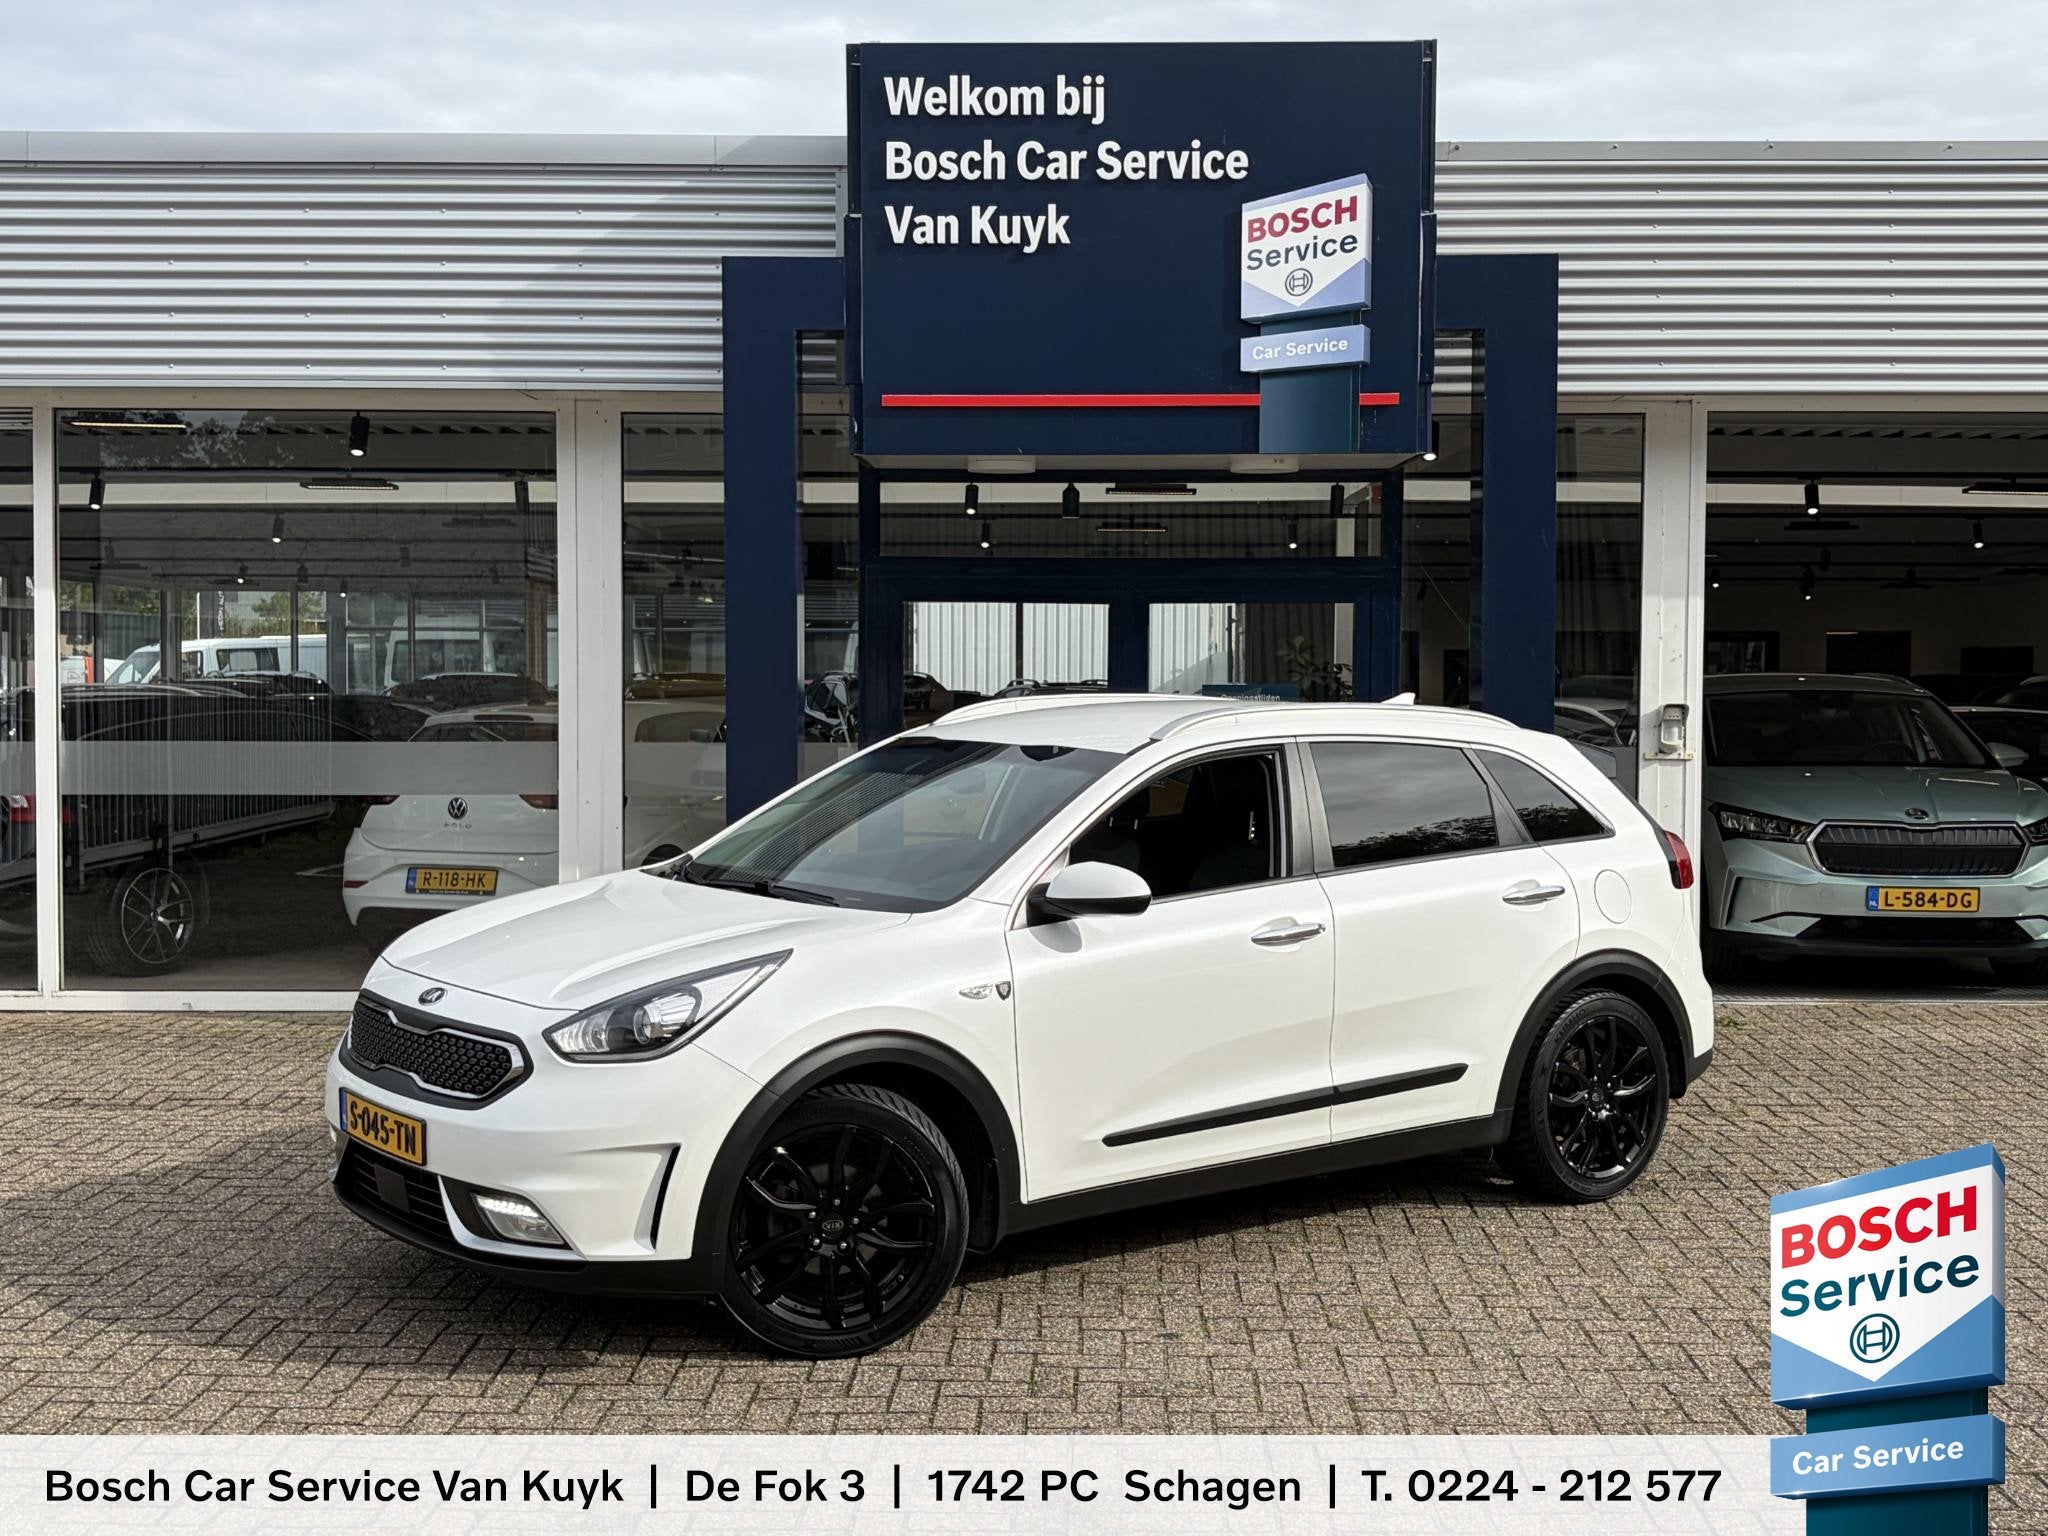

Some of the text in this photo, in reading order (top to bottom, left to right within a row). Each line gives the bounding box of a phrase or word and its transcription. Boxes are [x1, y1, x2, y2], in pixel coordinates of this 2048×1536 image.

[884, 74, 1105, 125] Welkom bij
[886, 139, 1250, 181] Bosch Car Service
[884, 203, 1071, 254] Van Kuyk
[1247, 195, 1358, 243] BOSCH
[1246, 234, 1358, 271] Service
[1252, 337, 1349, 360] Car Service
[423, 871, 486, 888] R-118-HK
[1884, 891, 1972, 908] L-584-DG
[350, 1100, 417, 1157] S-045-TN
